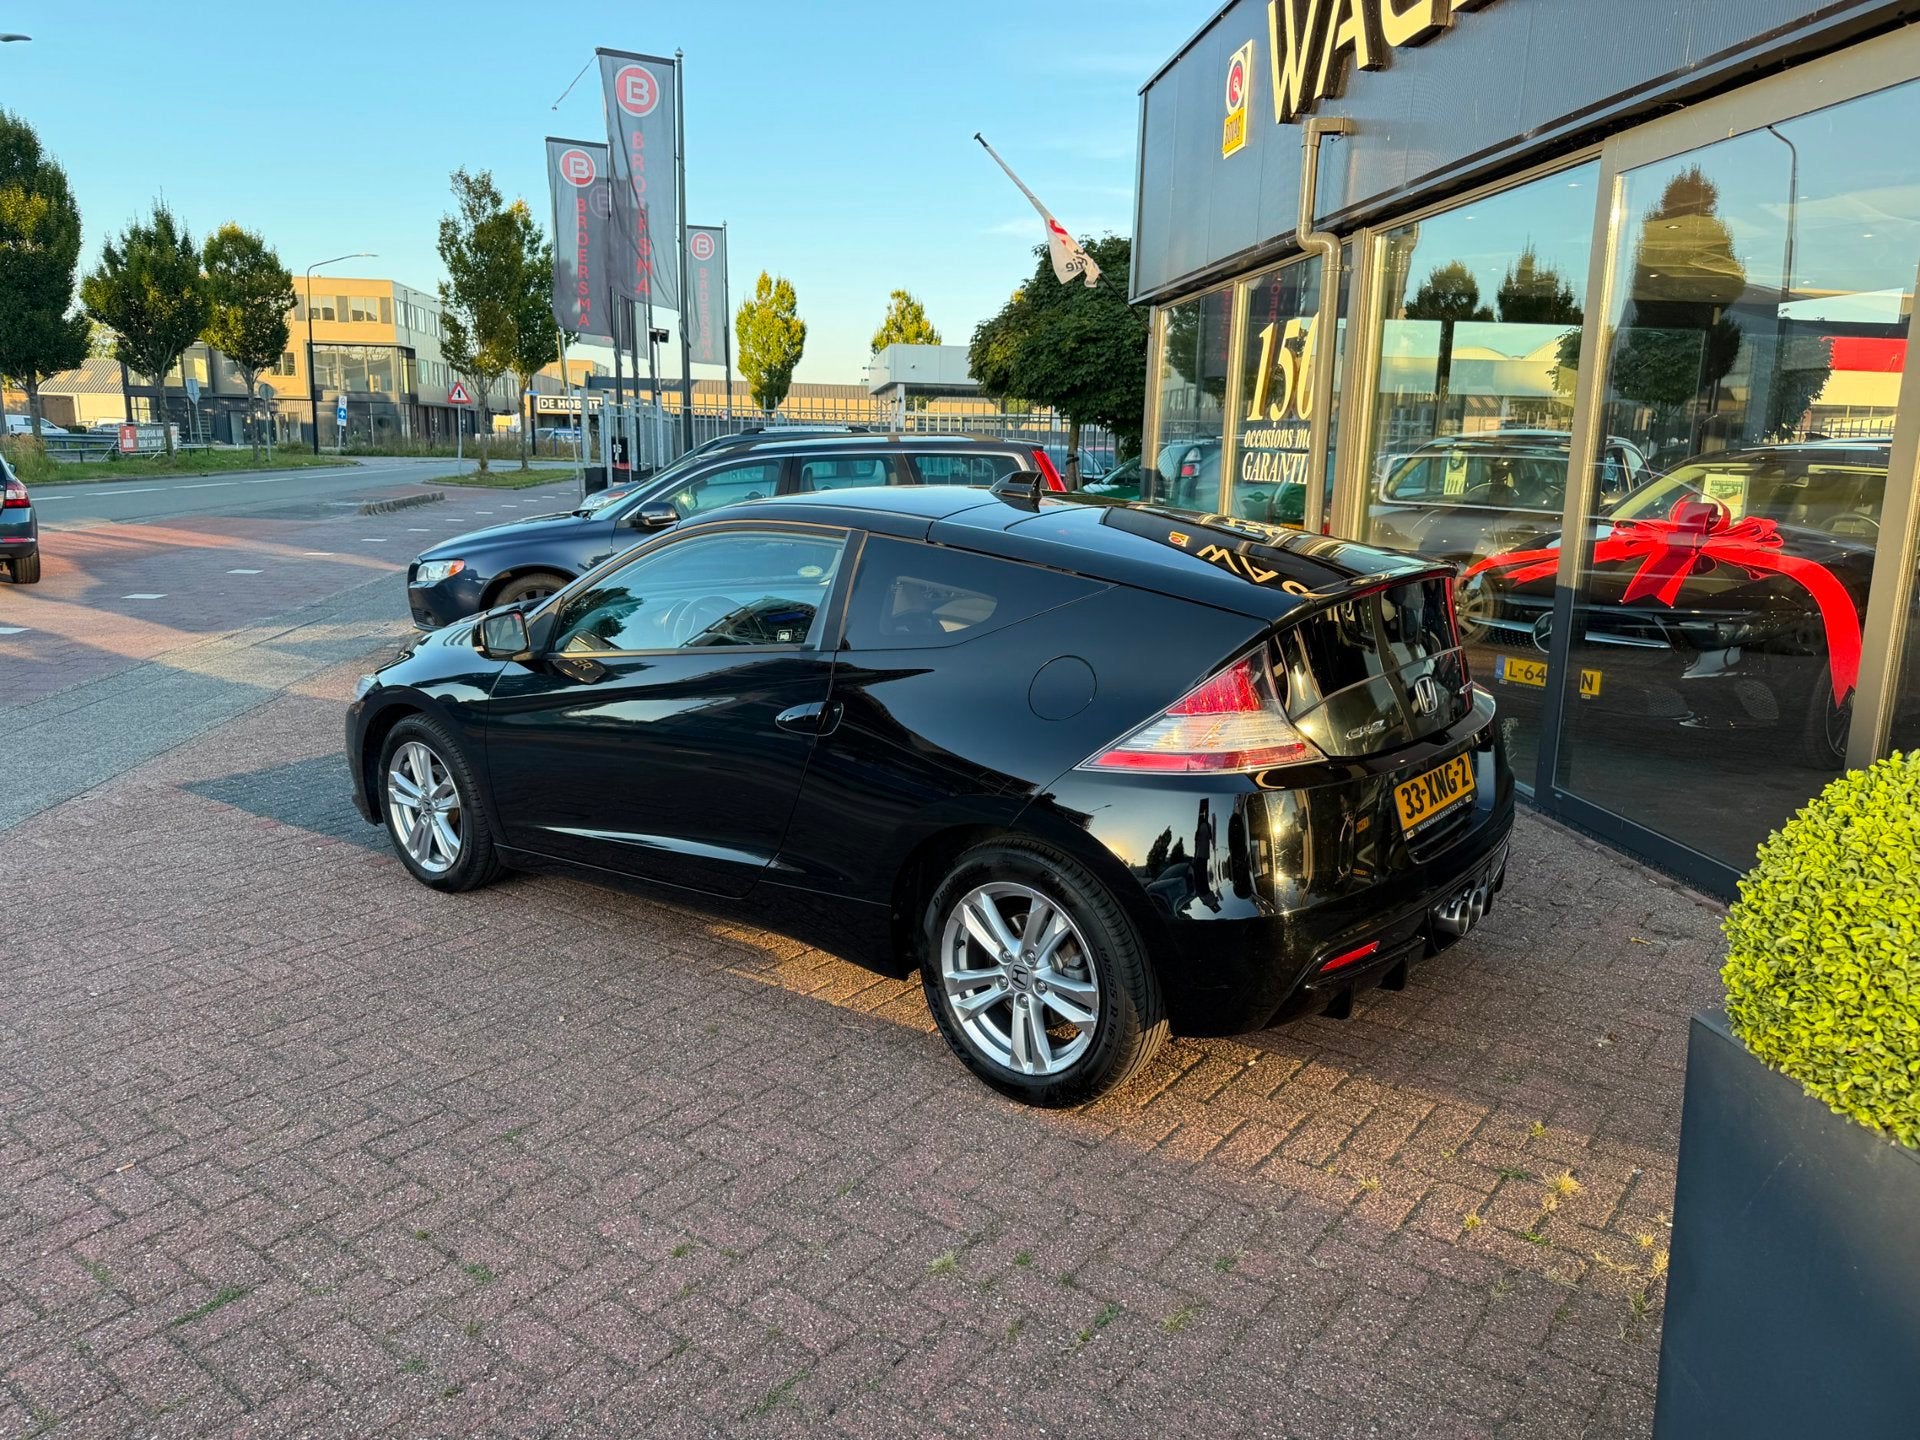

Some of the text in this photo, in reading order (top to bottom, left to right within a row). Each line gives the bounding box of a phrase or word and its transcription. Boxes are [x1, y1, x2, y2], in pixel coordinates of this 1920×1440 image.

[577, 198, 591, 327] BROERSMA
[541, 399, 600, 410] DE HOBIT
[1243, 422, 1294, 449] occasions
[1401, 757, 1471, 820] 33-XNG-2
